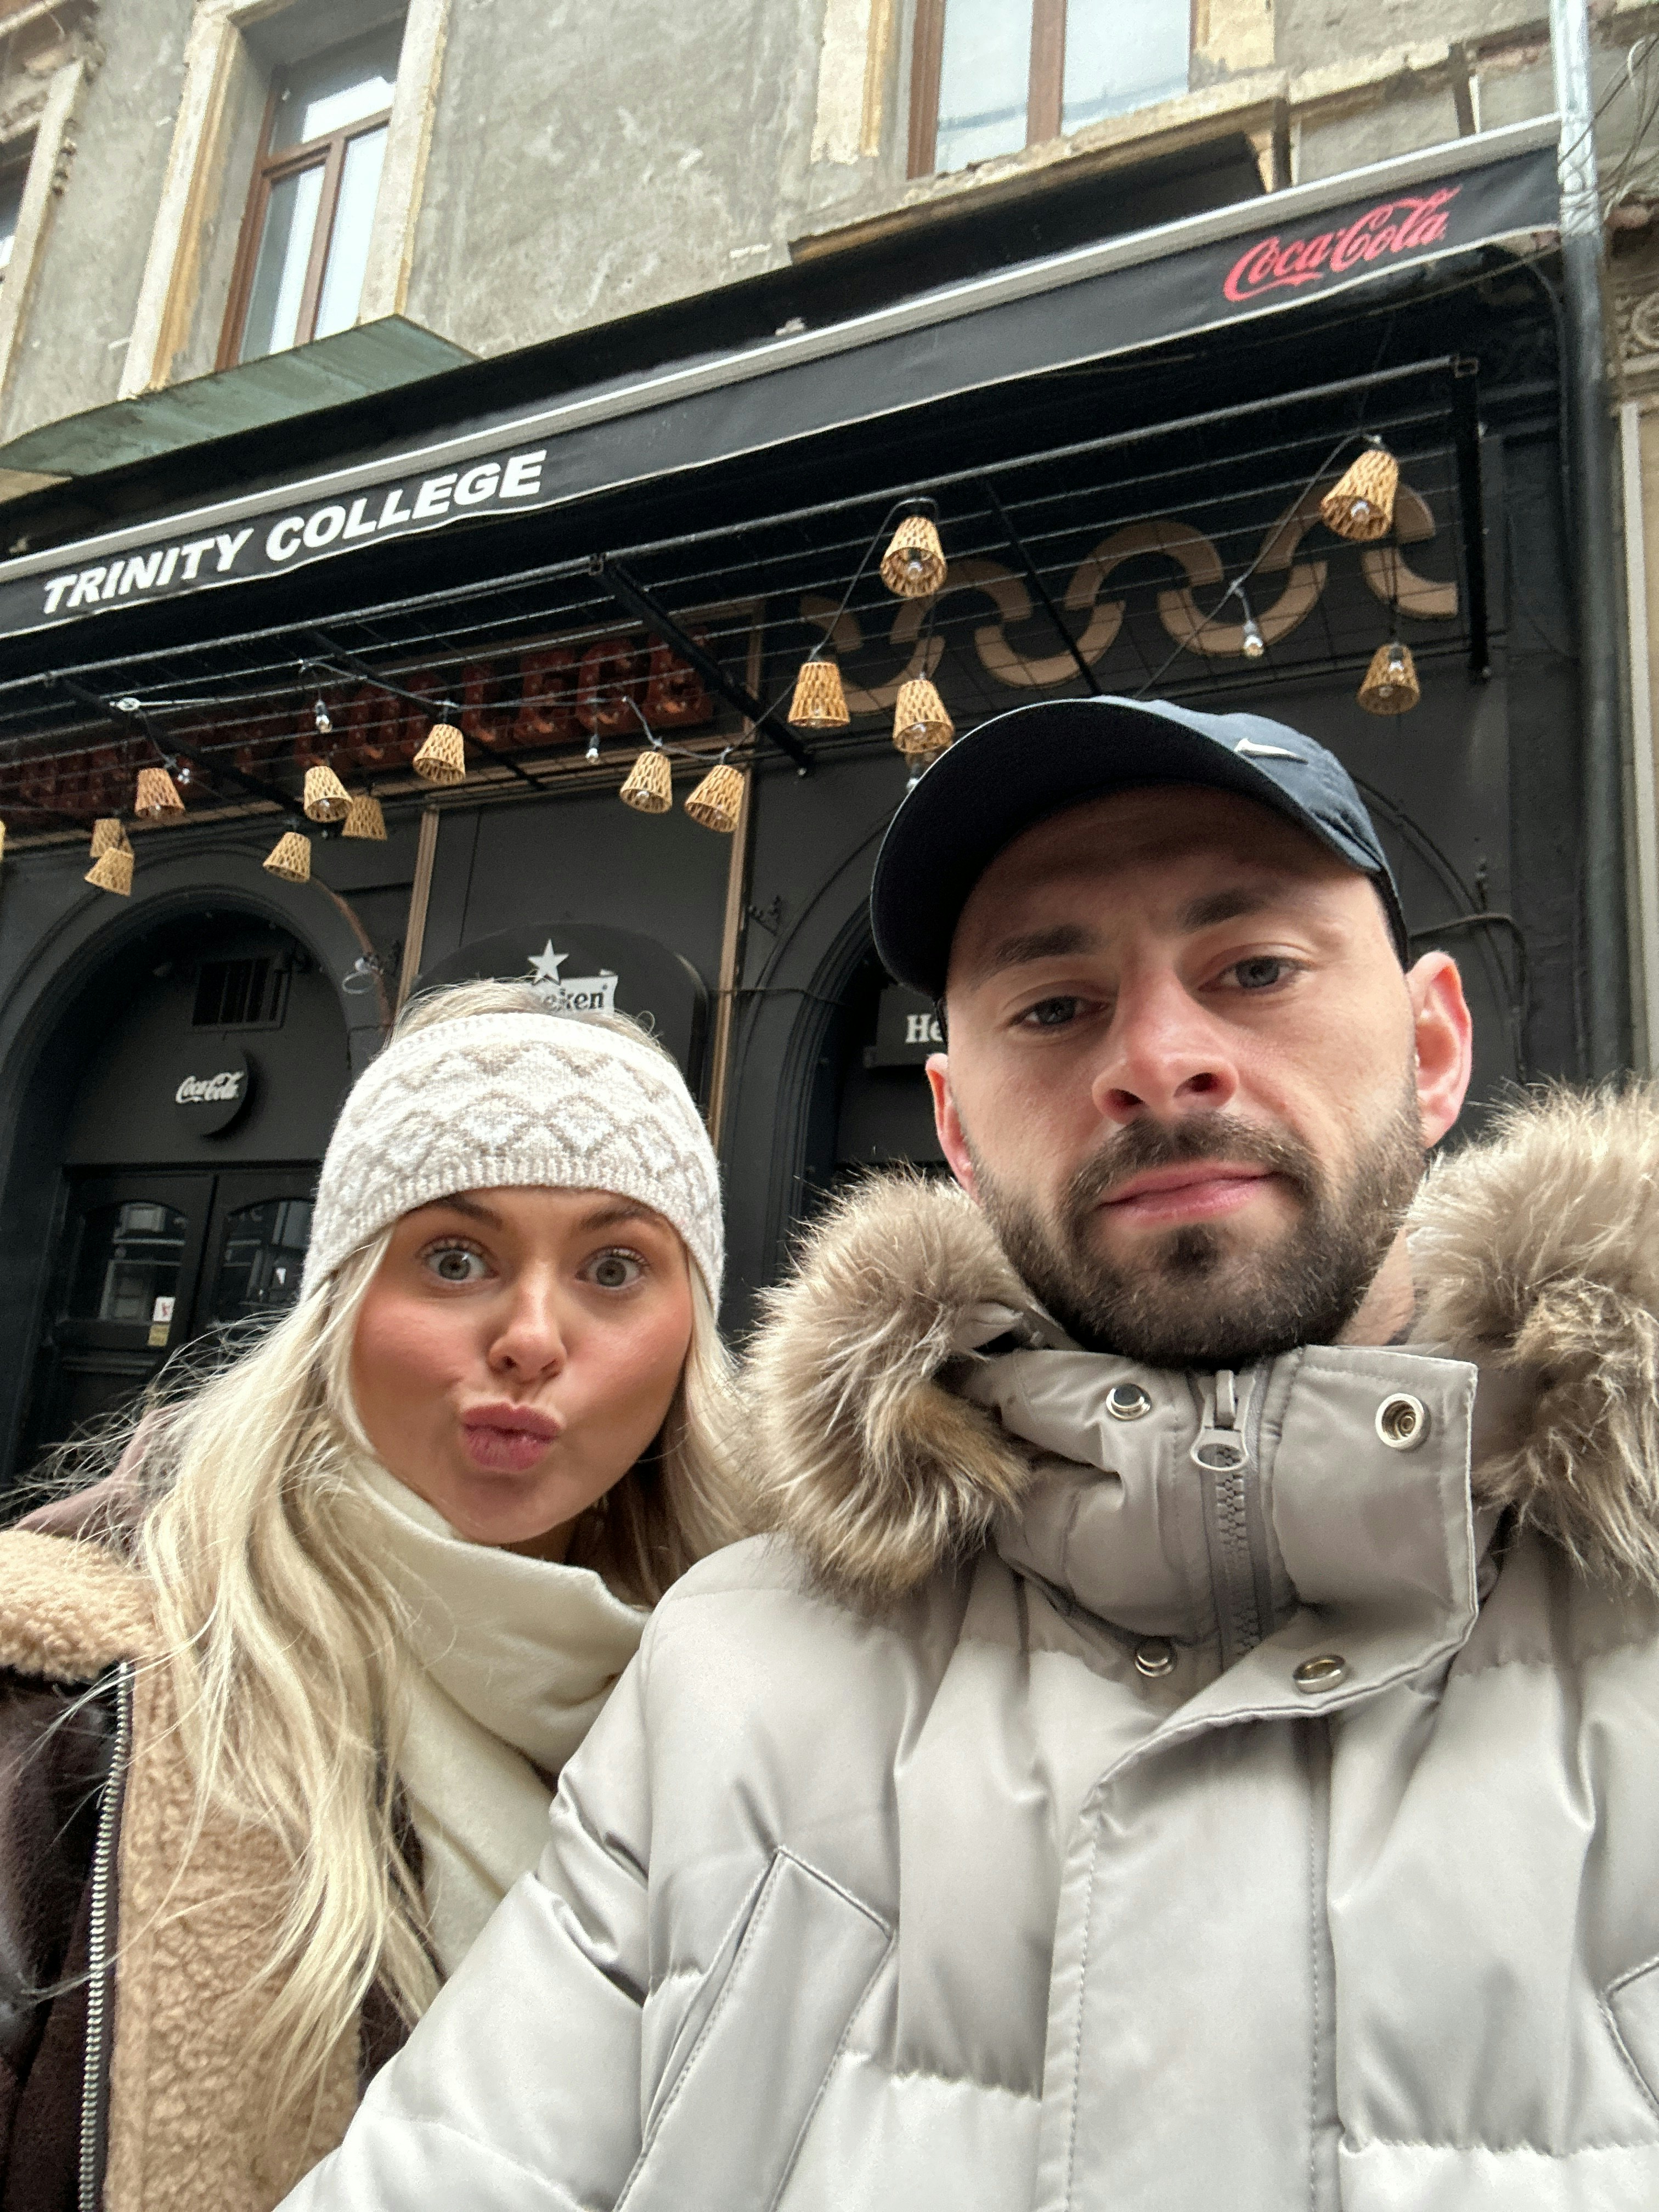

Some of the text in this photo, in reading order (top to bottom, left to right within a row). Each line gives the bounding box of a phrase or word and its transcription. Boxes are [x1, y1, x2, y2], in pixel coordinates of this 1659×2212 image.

[1224, 185, 1462, 301] Coca-Cola
[43, 449, 547, 614] TRINITY COLLEGE
[176, 1071, 245, 1103] Coca-Cola
